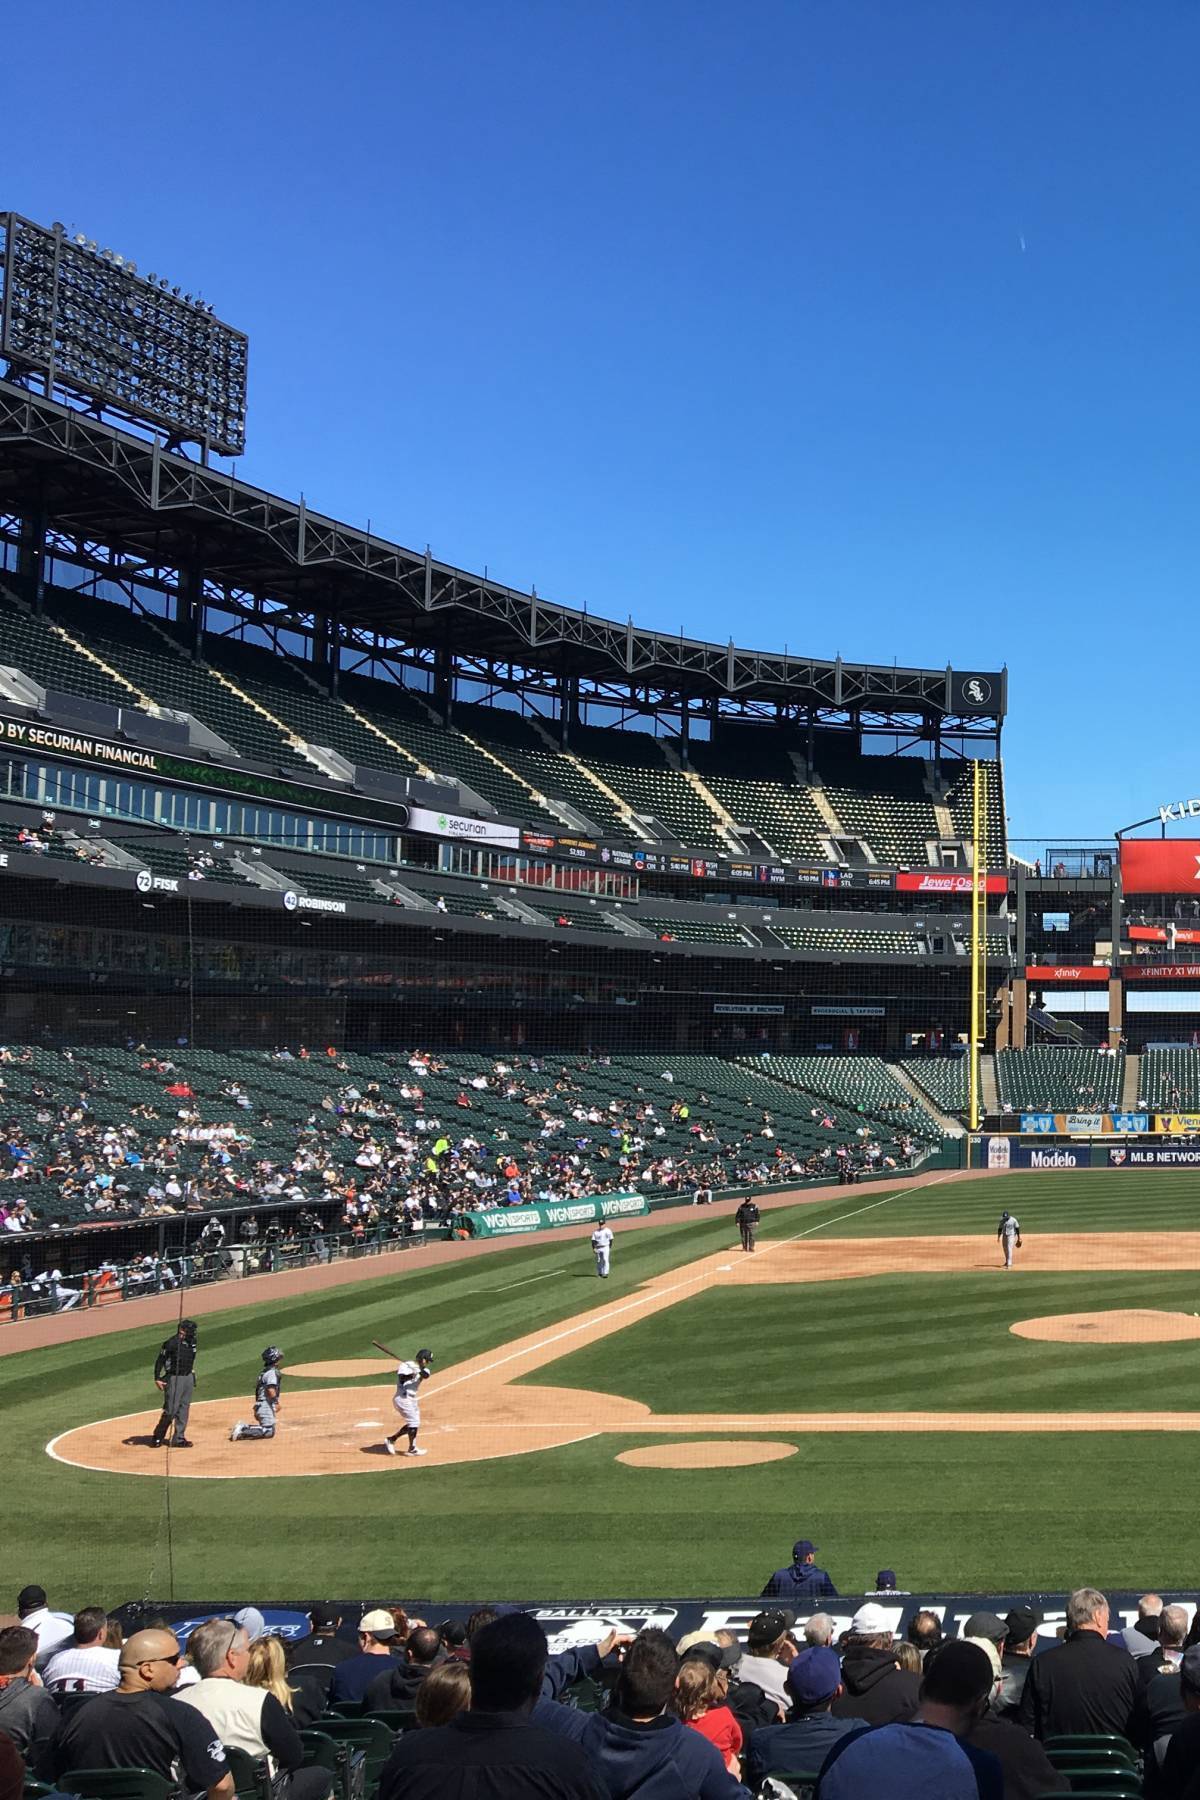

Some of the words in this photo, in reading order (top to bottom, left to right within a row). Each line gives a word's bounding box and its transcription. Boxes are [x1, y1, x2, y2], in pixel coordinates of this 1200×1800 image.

[8, 724, 26, 739] BY
[28, 728, 92, 756] SECURIAN
[94, 744, 158, 769] FINANCIAL
[448, 820, 486, 834] securian
[138, 876, 150, 886] 72
[154, 878, 178, 892] FISK
[919, 876, 986, 890] Jewel-Oso
[286, 896, 296, 906] 42
[299, 898, 346, 912] ROBINSON
[1054, 968, 1081, 978] xfinity
[1142, 967, 1172, 976] XFINITY
[1175, 967, 1185, 975] X1
[1068, 1116, 1092, 1127] Bring
[1094, 1115, 1101, 1125] it
[1031, 1151, 1076, 1167] Modelo
[1130, 1152, 1154, 1162] MLB
[536, 1608, 658, 1617] BALLPARK
